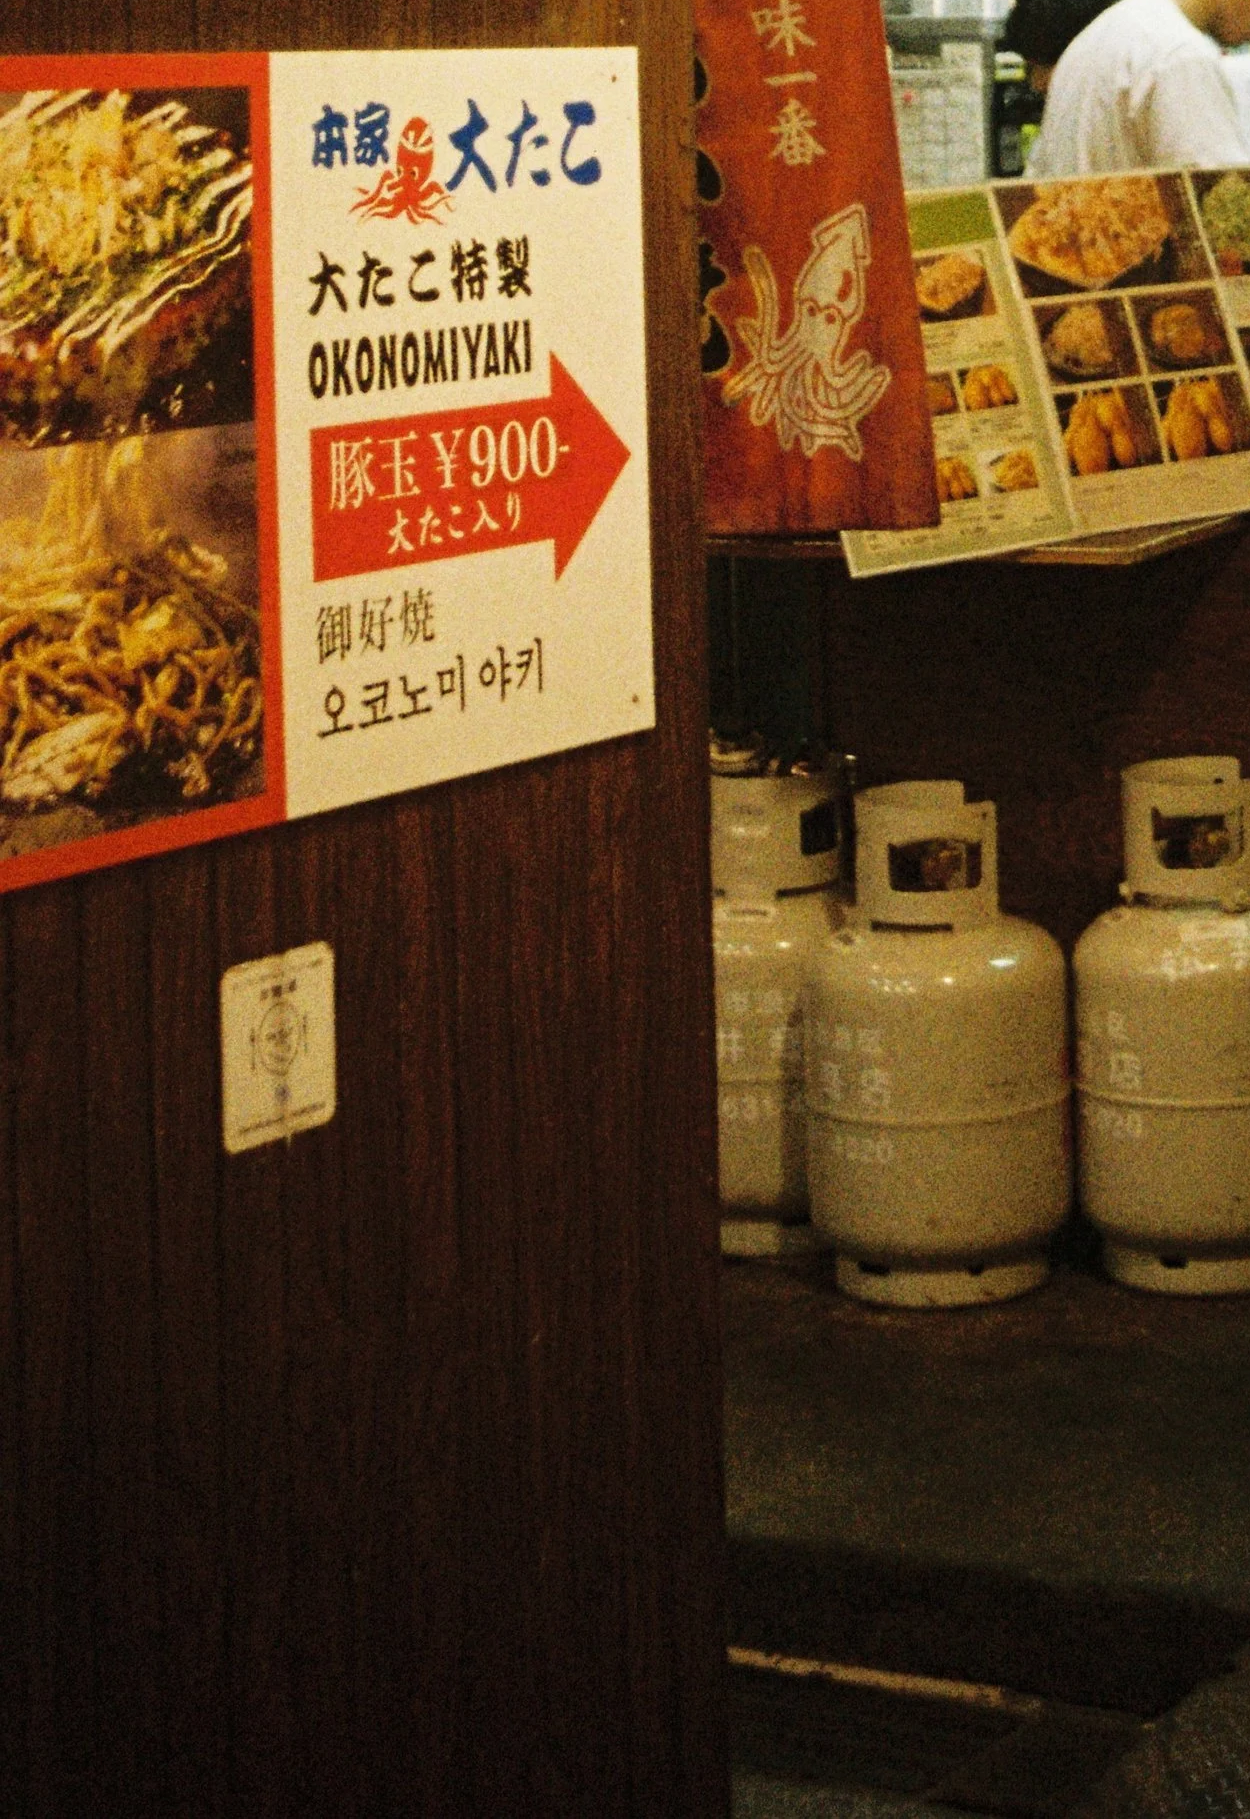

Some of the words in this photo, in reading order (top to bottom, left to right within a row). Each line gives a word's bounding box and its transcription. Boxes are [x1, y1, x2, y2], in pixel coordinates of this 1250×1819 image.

[445, 98, 602, 194] 大たこ
[308, 236, 532, 316] 大たこ特製
[308, 317, 532, 400] OKONOMIYAKI
[387, 491, 522, 555] 大たこ入り
[315, 586, 437, 664] 御好焼
